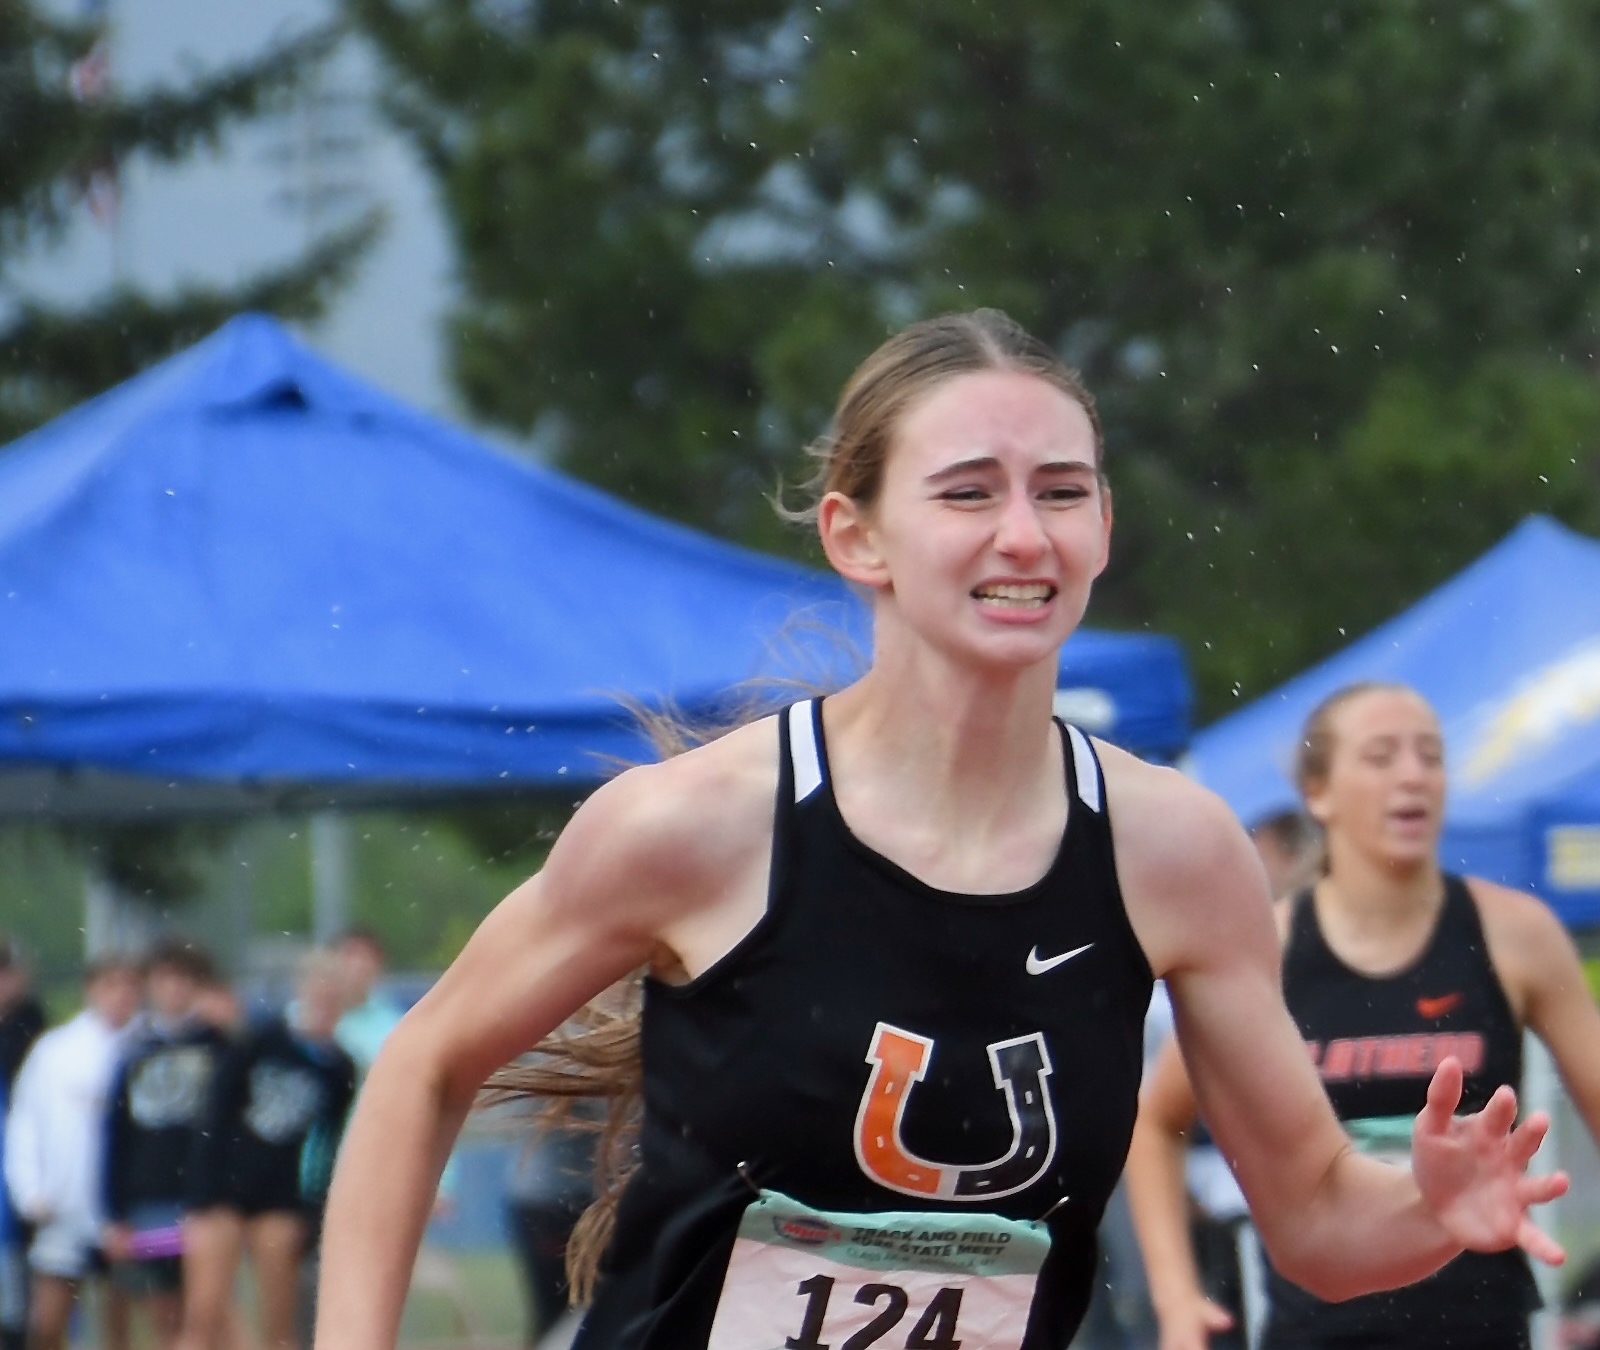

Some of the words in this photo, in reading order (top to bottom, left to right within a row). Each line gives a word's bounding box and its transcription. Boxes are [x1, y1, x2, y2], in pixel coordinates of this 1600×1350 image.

[1304, 1032, 1485, 1081] LATHEAD
[853, 1226, 914, 1243] TRACK
[918, 1228, 957, 1243] AND
[961, 1230, 1012, 1245] FIELD
[903, 1242, 951, 1258] STATE
[956, 1243, 1006, 1256] MEET
